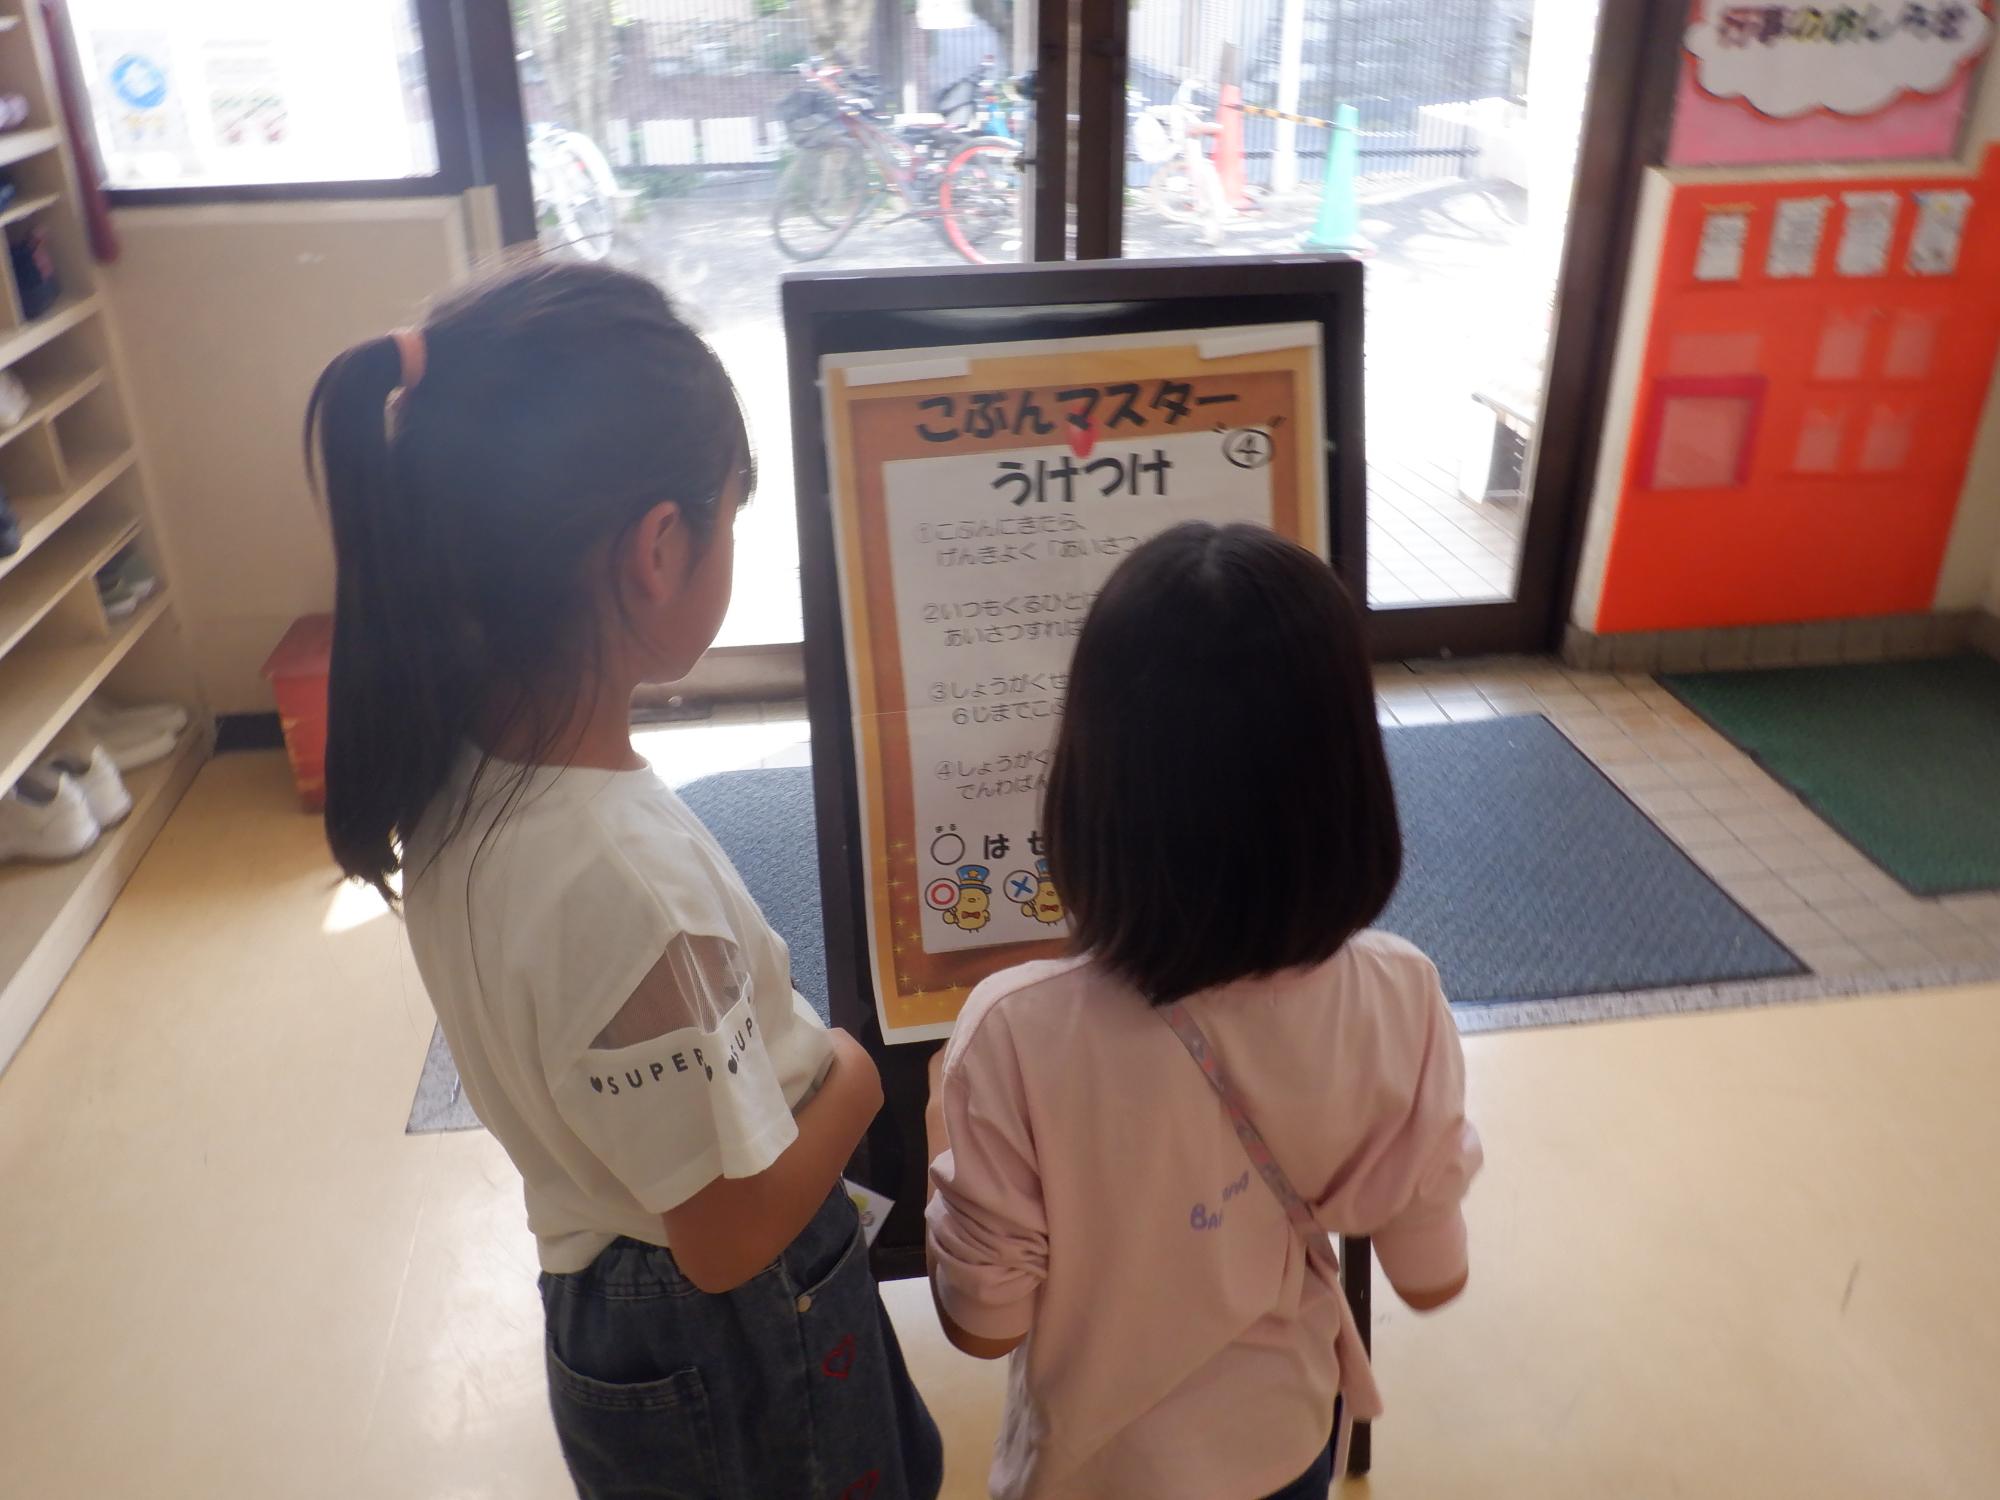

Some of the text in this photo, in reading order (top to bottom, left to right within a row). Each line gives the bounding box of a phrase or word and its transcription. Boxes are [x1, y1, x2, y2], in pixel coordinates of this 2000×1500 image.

[916, 379, 1239, 443] こぶんマスター
[990, 450, 1174, 505] うけつけ
